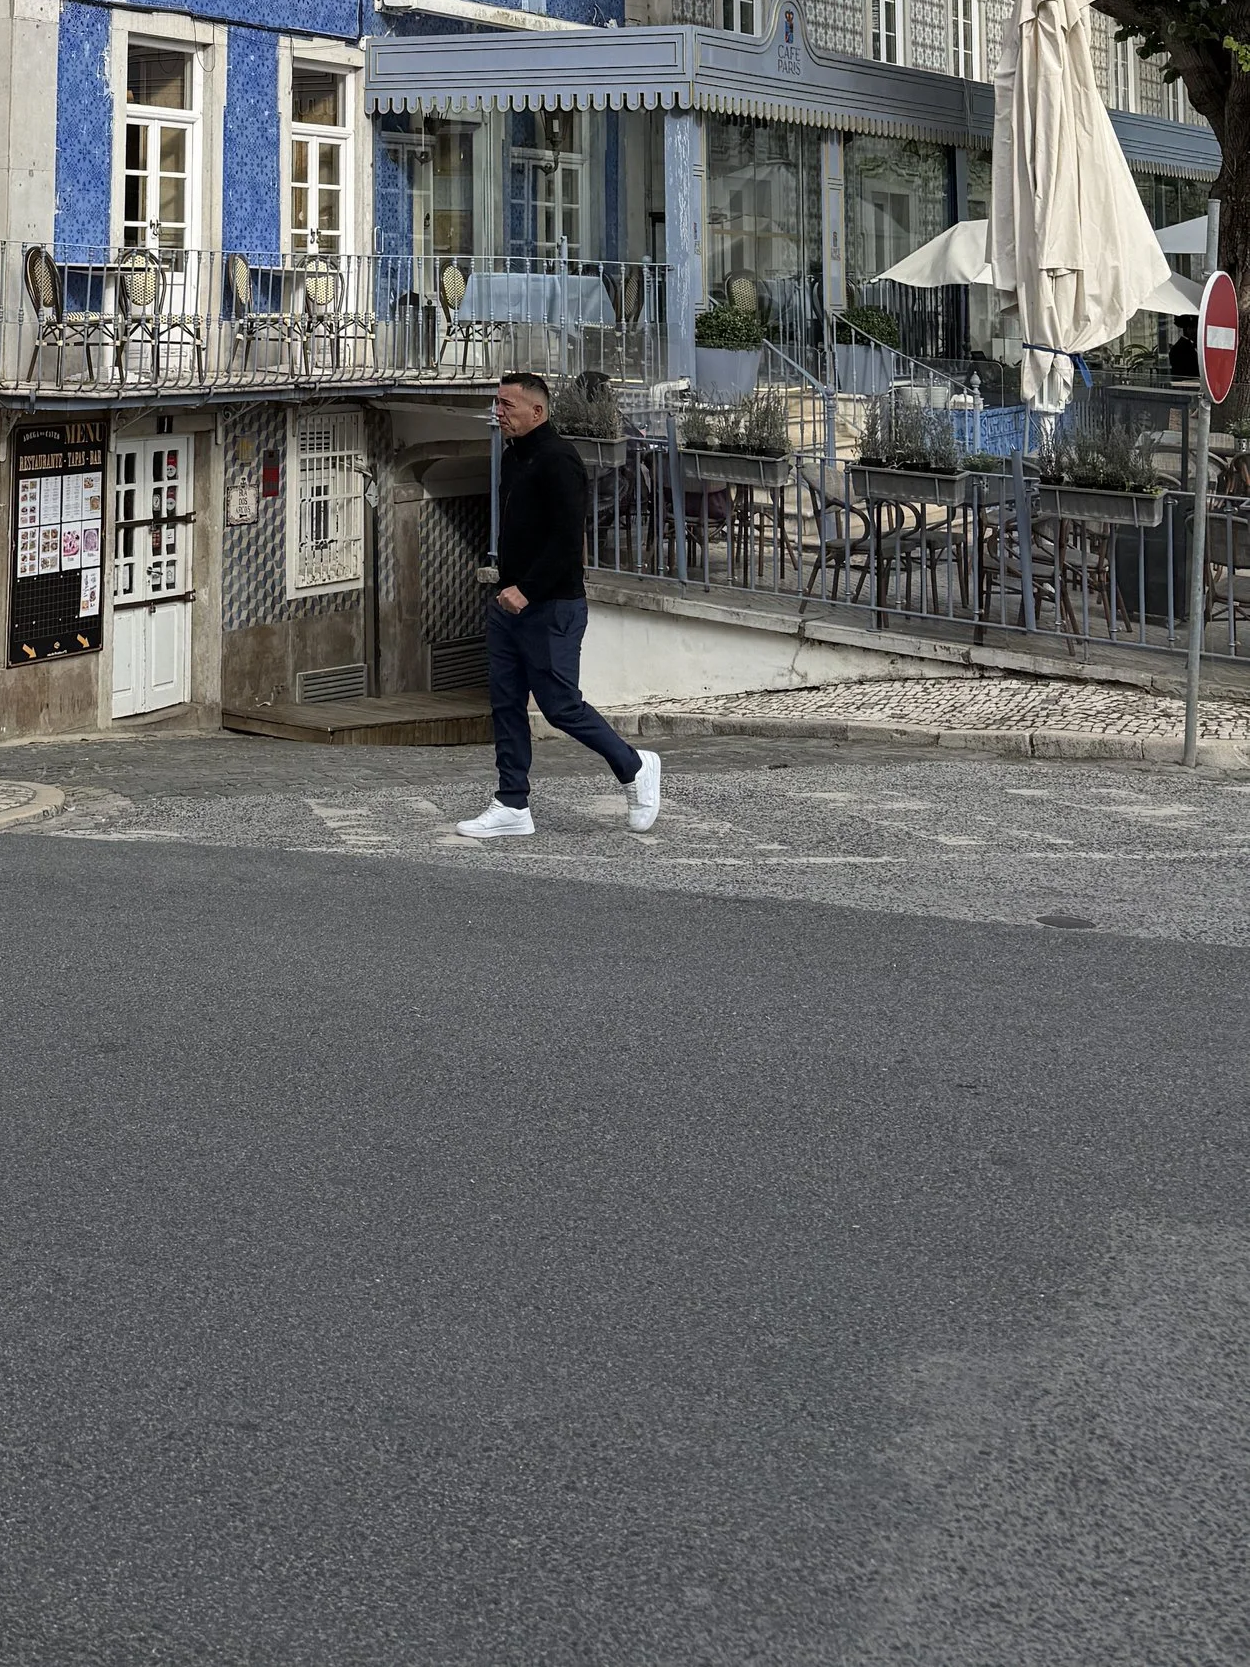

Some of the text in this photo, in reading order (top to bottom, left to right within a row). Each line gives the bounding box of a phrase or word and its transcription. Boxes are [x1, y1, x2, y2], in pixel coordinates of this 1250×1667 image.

[778, 59, 801, 75] PARIS
[64, 422, 105, 444] MENU
[19, 450, 102, 472] RESTAURANTE TAPAS BAR
